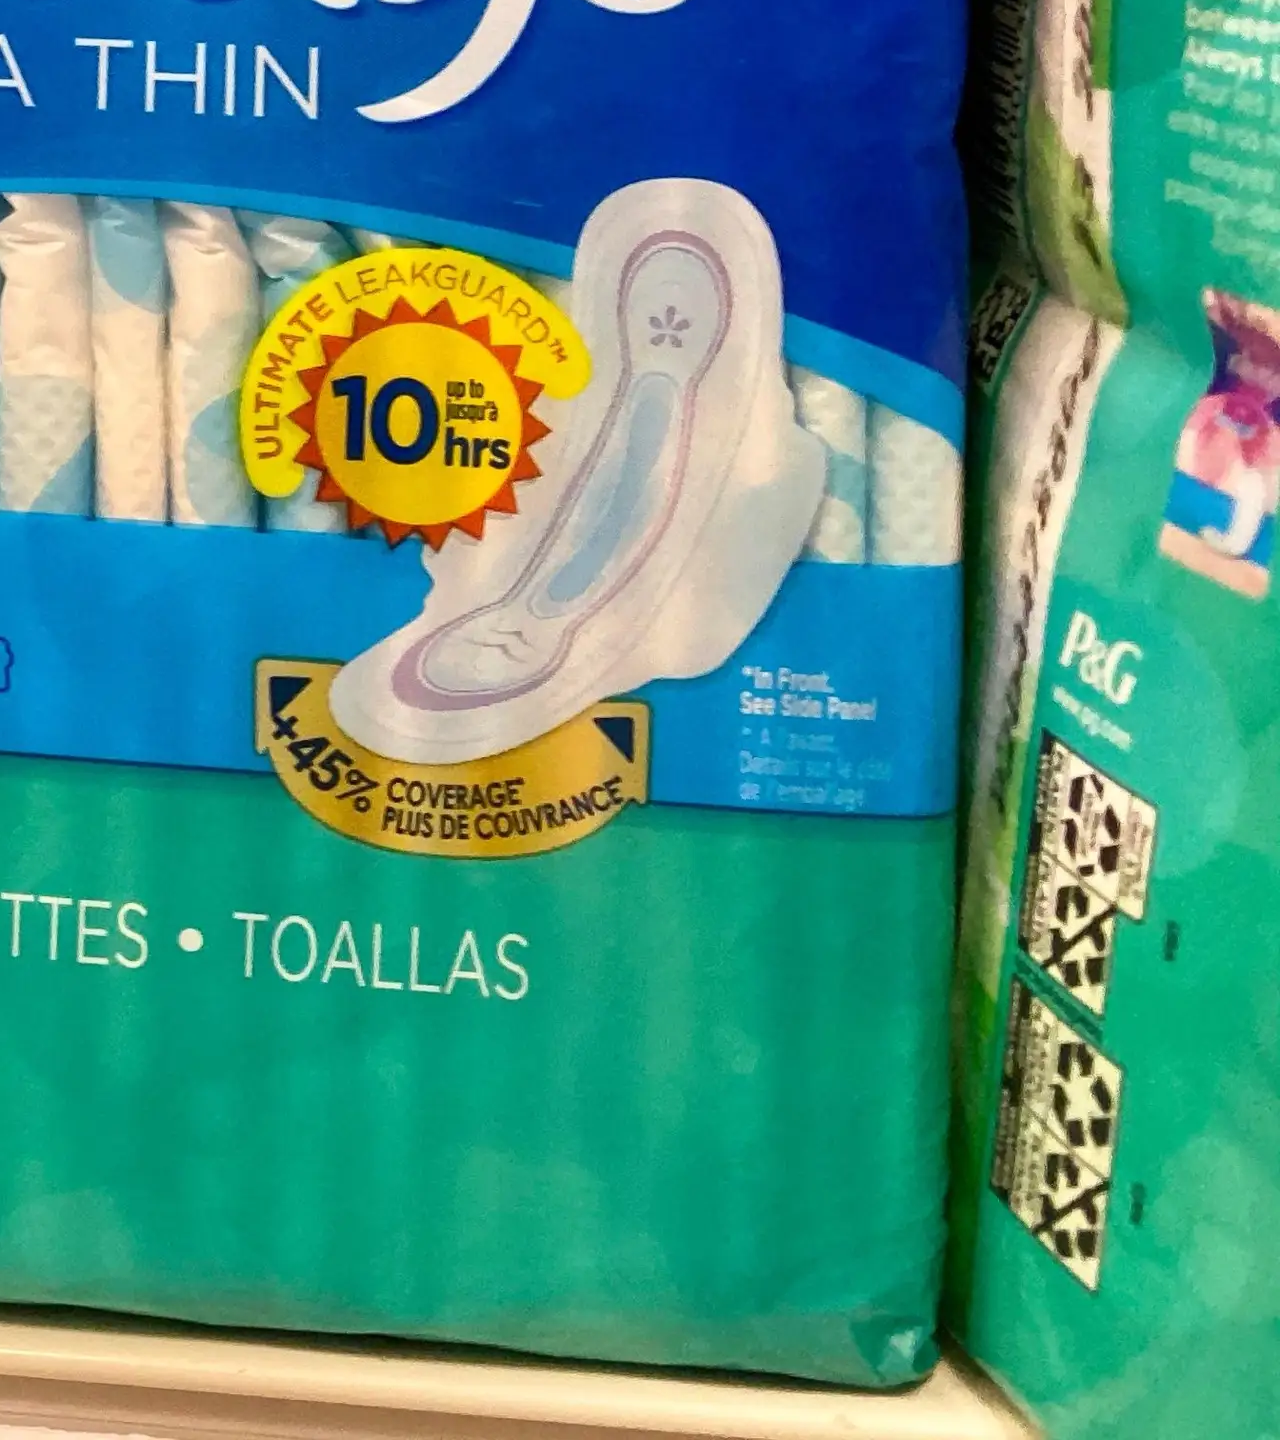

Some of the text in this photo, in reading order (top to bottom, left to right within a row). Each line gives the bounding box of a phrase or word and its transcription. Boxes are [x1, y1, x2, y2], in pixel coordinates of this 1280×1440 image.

[75, 35, 320, 120] THIN
[253, 293, 334, 460] ULTIMATE
[330, 375, 439, 466] 10
[469, 379, 484, 398] to
[444, 427, 511, 470] hrs
[1059, 610, 1143, 704] P&G
[739, 691, 877, 721] See Side Panel
[272, 713, 524, 813] +45% COVERAGE
[382, 776, 625, 840] PLUS DE COUVRANCE
[233, 910, 532, 1004] TOALLAS
